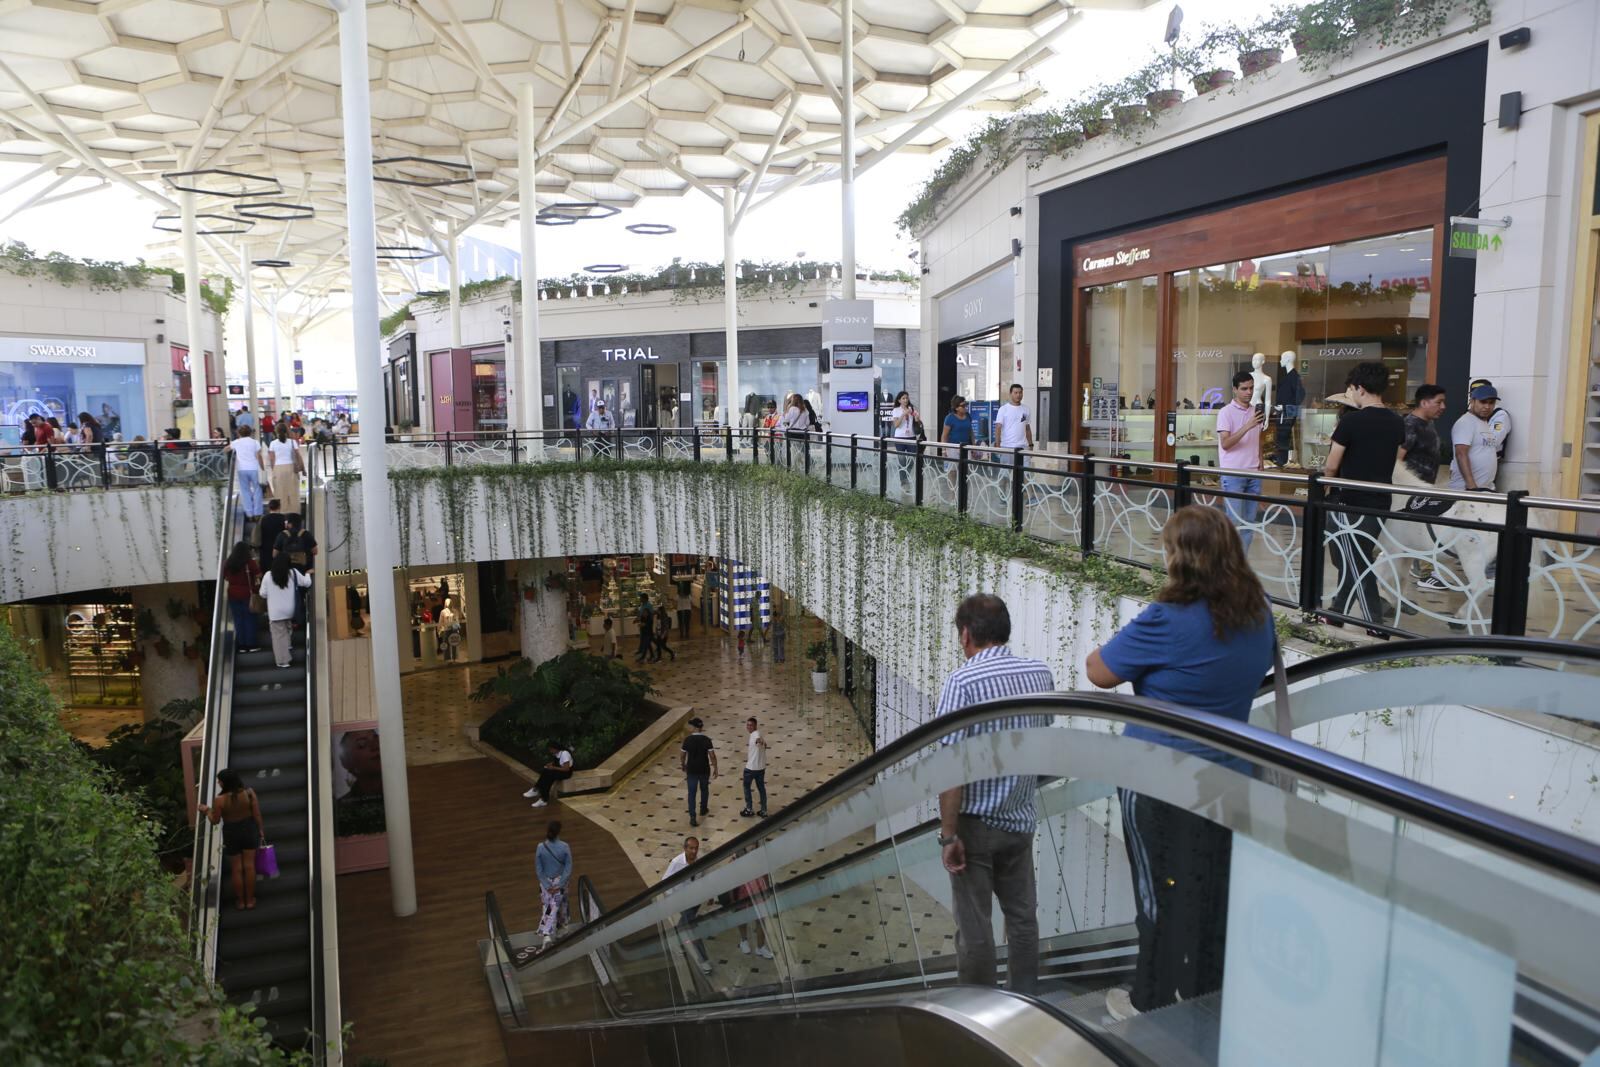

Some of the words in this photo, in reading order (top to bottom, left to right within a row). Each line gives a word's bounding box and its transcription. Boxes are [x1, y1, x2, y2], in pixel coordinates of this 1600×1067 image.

[1452, 231, 1489, 251] SALIDA
[1082, 256, 1114, 272] Carmen
[1115, 247, 1151, 266] Steffens
[964, 297, 984, 319] SONY
[834, 316, 868, 324] SONY
[30, 344, 97, 358] SWAROVSKI
[602, 347, 659, 361] TRIAL
